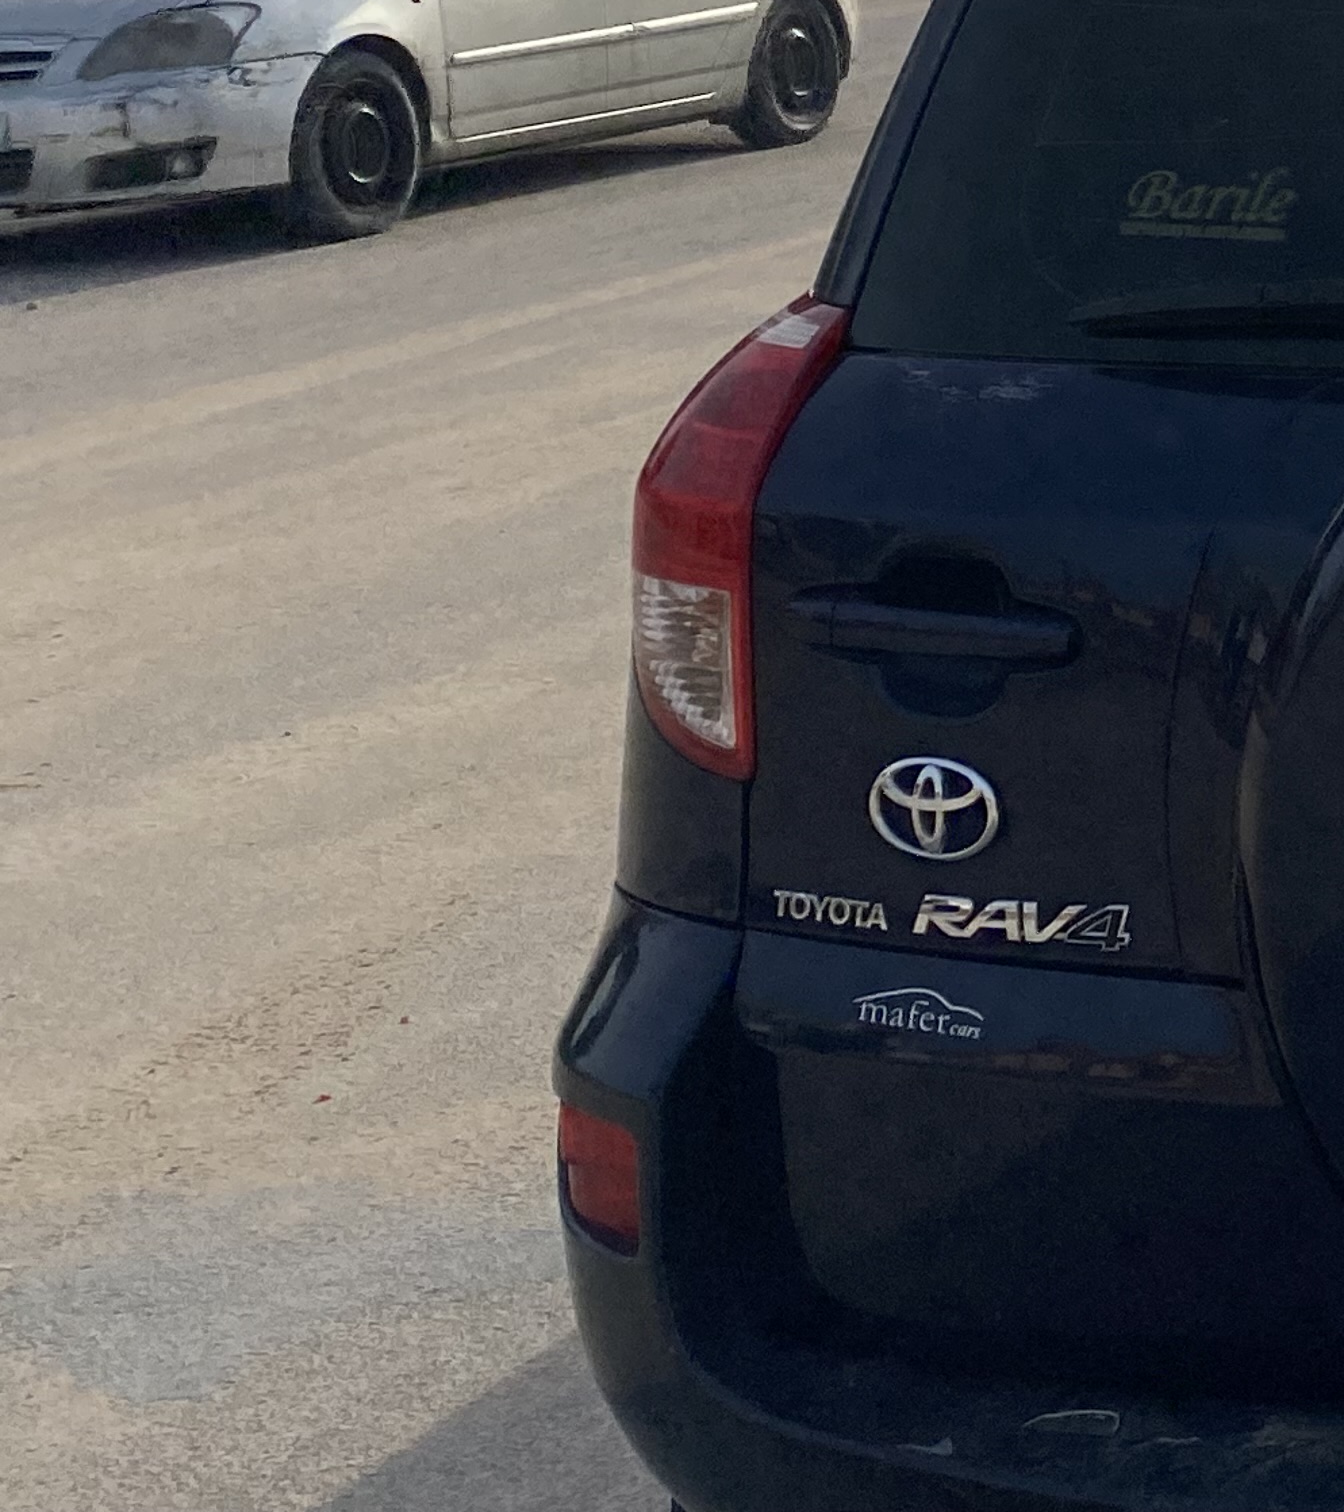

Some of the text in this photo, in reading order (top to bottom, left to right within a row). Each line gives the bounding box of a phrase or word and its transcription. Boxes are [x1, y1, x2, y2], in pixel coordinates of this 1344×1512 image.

[774, 889, 1131, 952] TOYOTA RAV4
[858, 1000, 981, 1039] mafer cars
